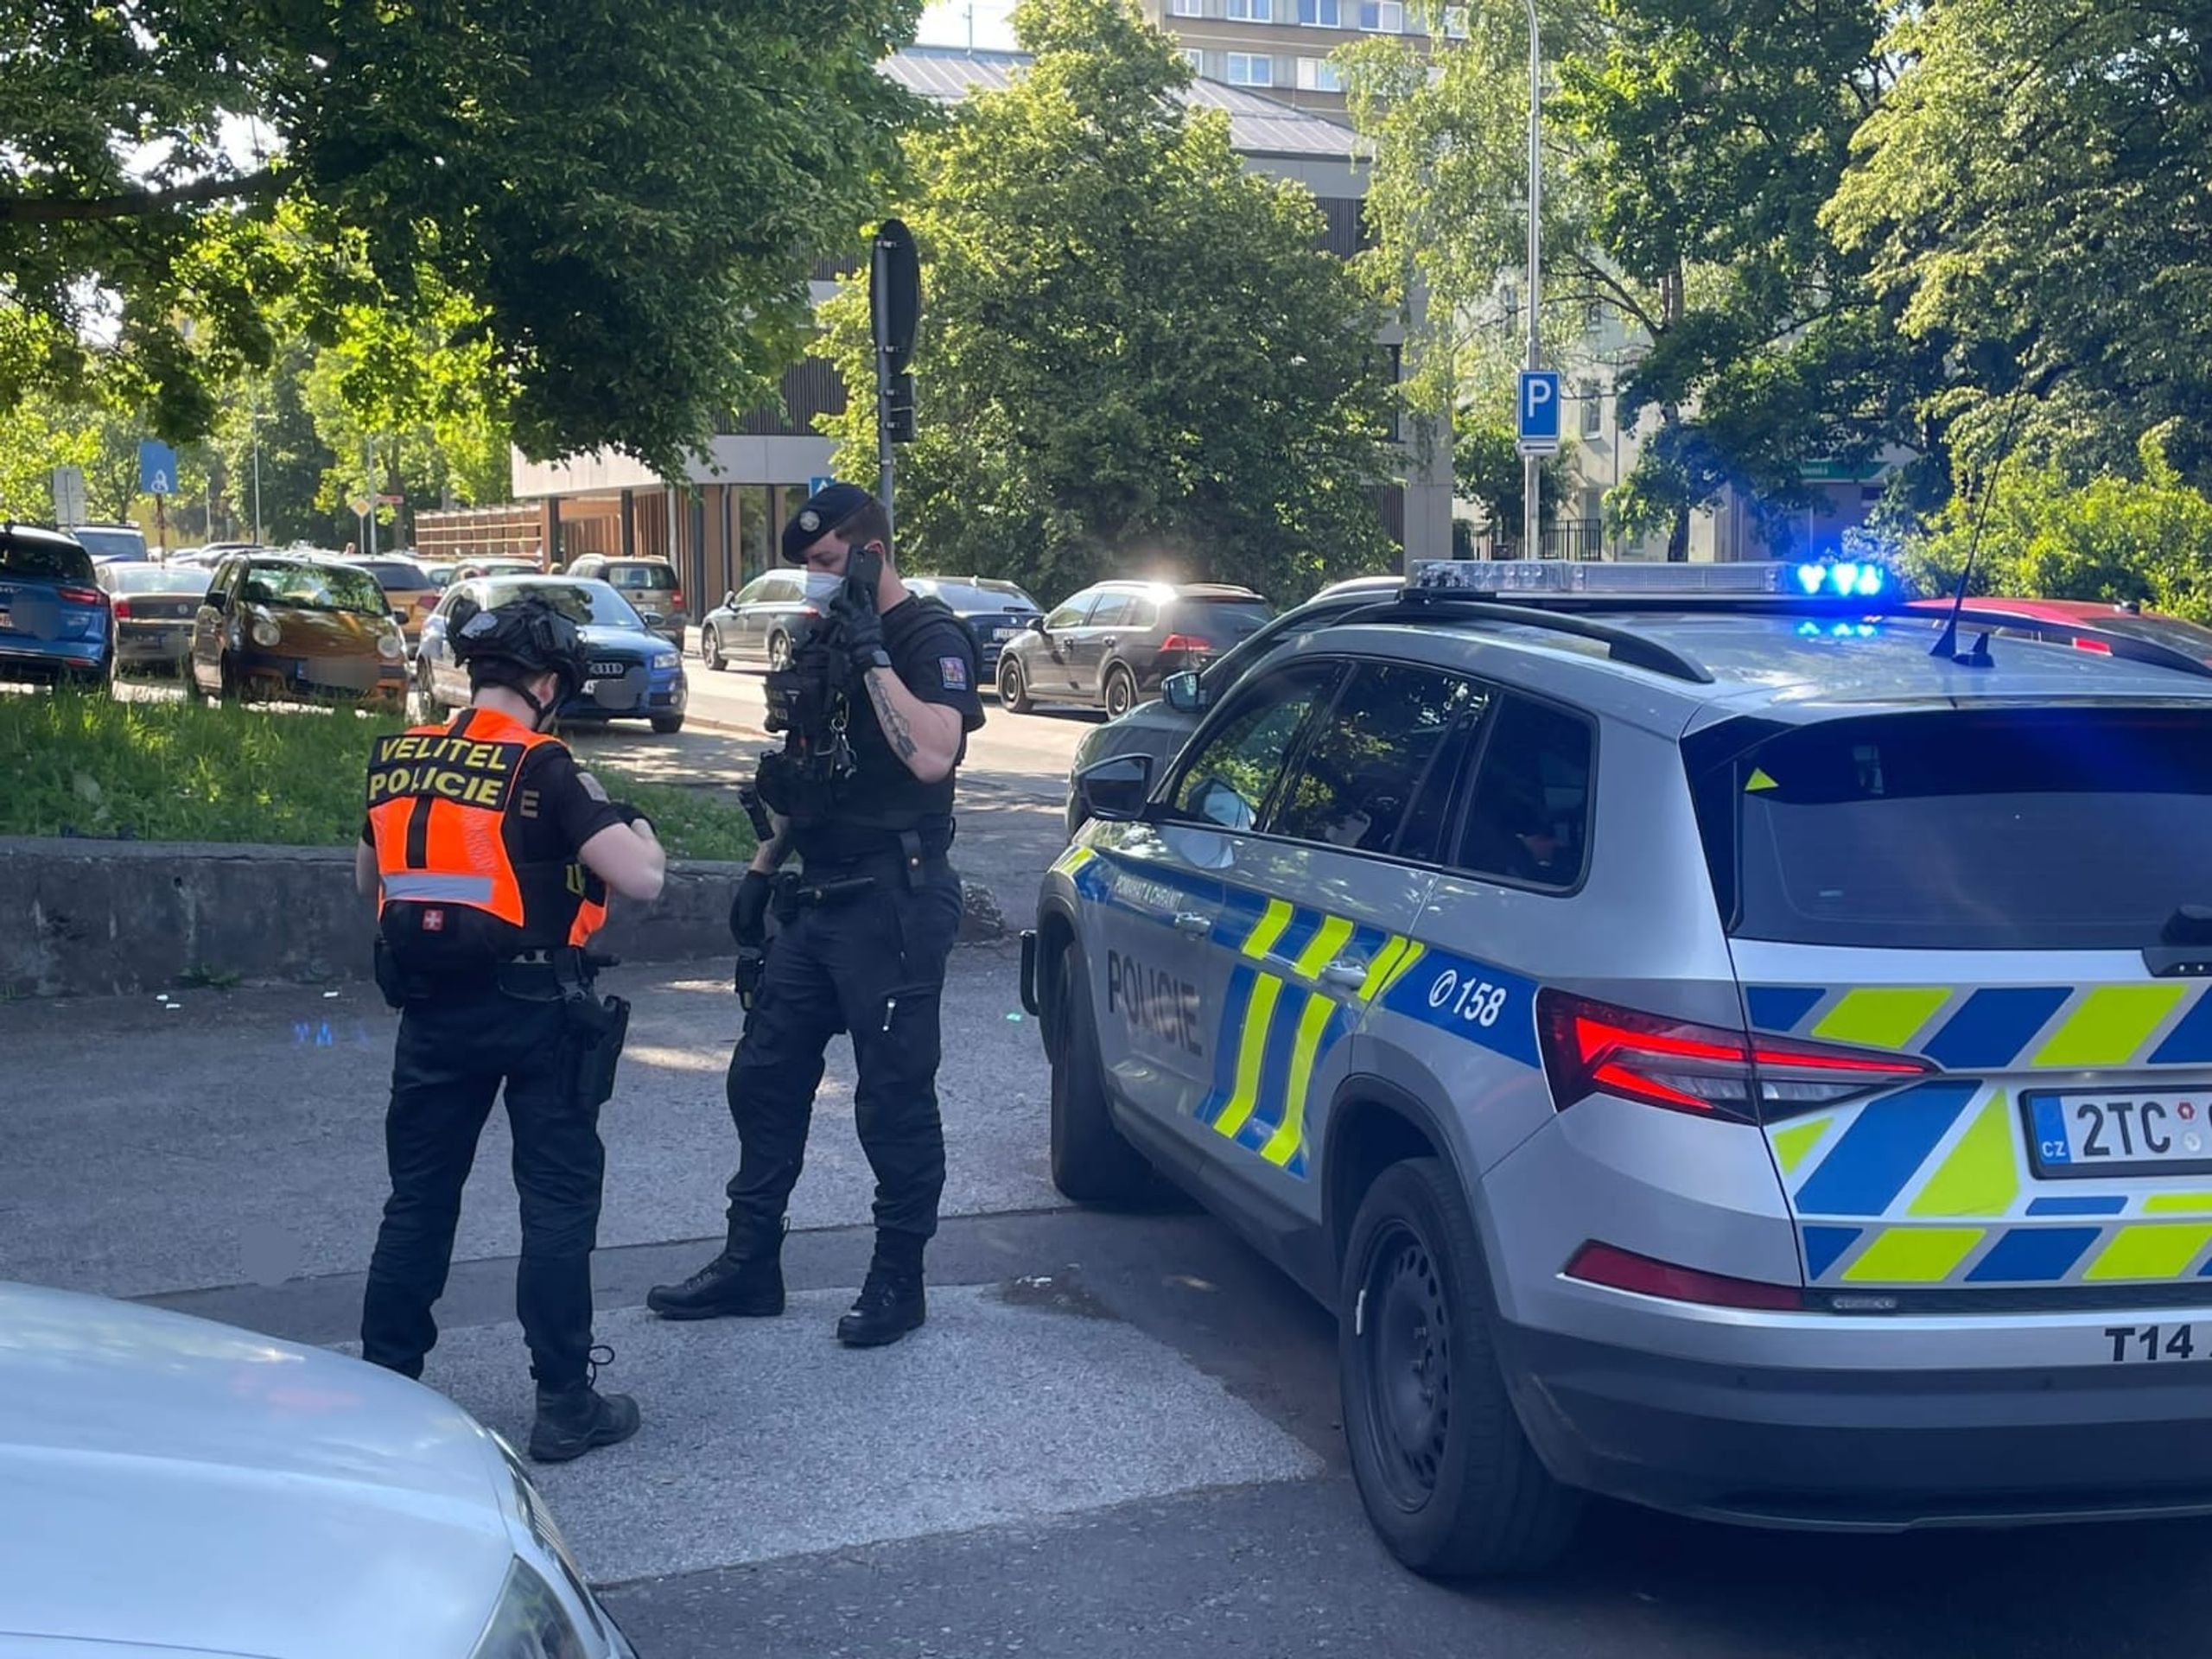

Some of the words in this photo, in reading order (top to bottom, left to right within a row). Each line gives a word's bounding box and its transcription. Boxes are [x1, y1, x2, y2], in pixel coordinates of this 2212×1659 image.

[1528, 378, 1552, 418] P
[380, 737, 507, 771] VELITEL
[368, 766, 504, 806] POLICIE
[1108, 948, 1202, 1057] POLICIE
[1453, 977, 1506, 1027] 158
[2042, 1141, 2067, 1157] CZ
[2105, 1324, 2194, 1363] T14
